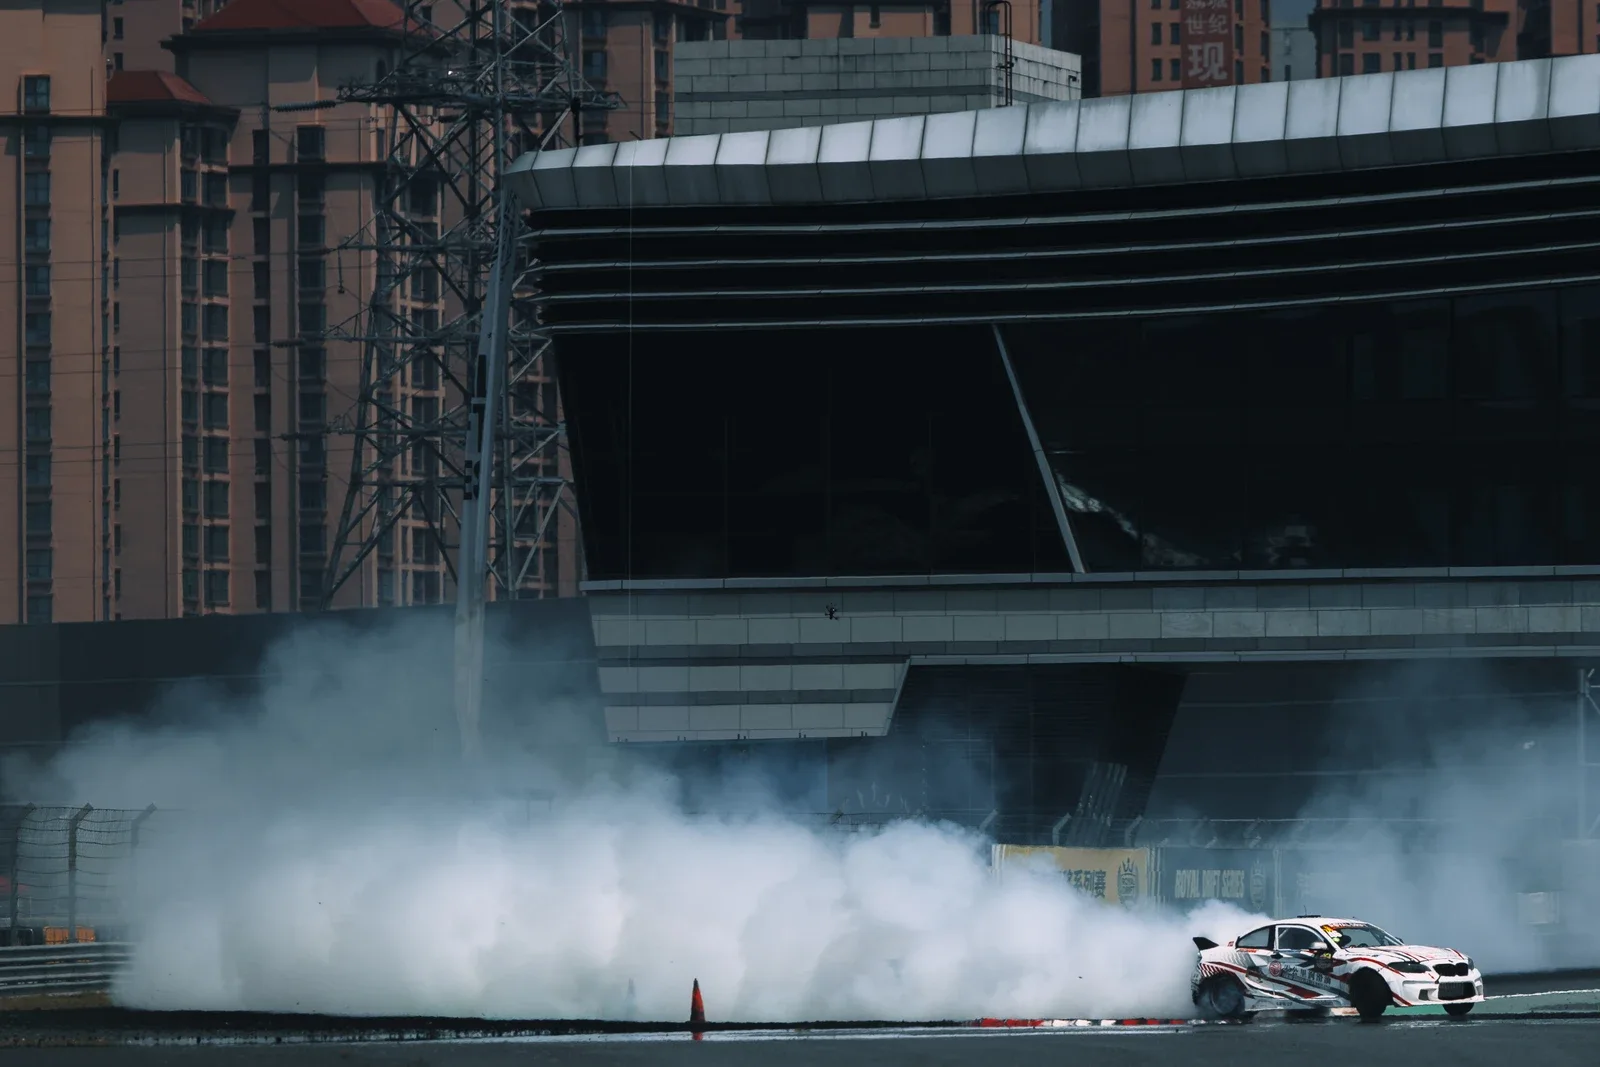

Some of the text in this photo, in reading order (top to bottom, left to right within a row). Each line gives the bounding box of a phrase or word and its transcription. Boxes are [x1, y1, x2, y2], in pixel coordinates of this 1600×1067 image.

[1186, 14, 1228, 35] 世纪
[1187, 42, 1228, 81] 现
[1175, 869, 1200, 898] ROYAL
